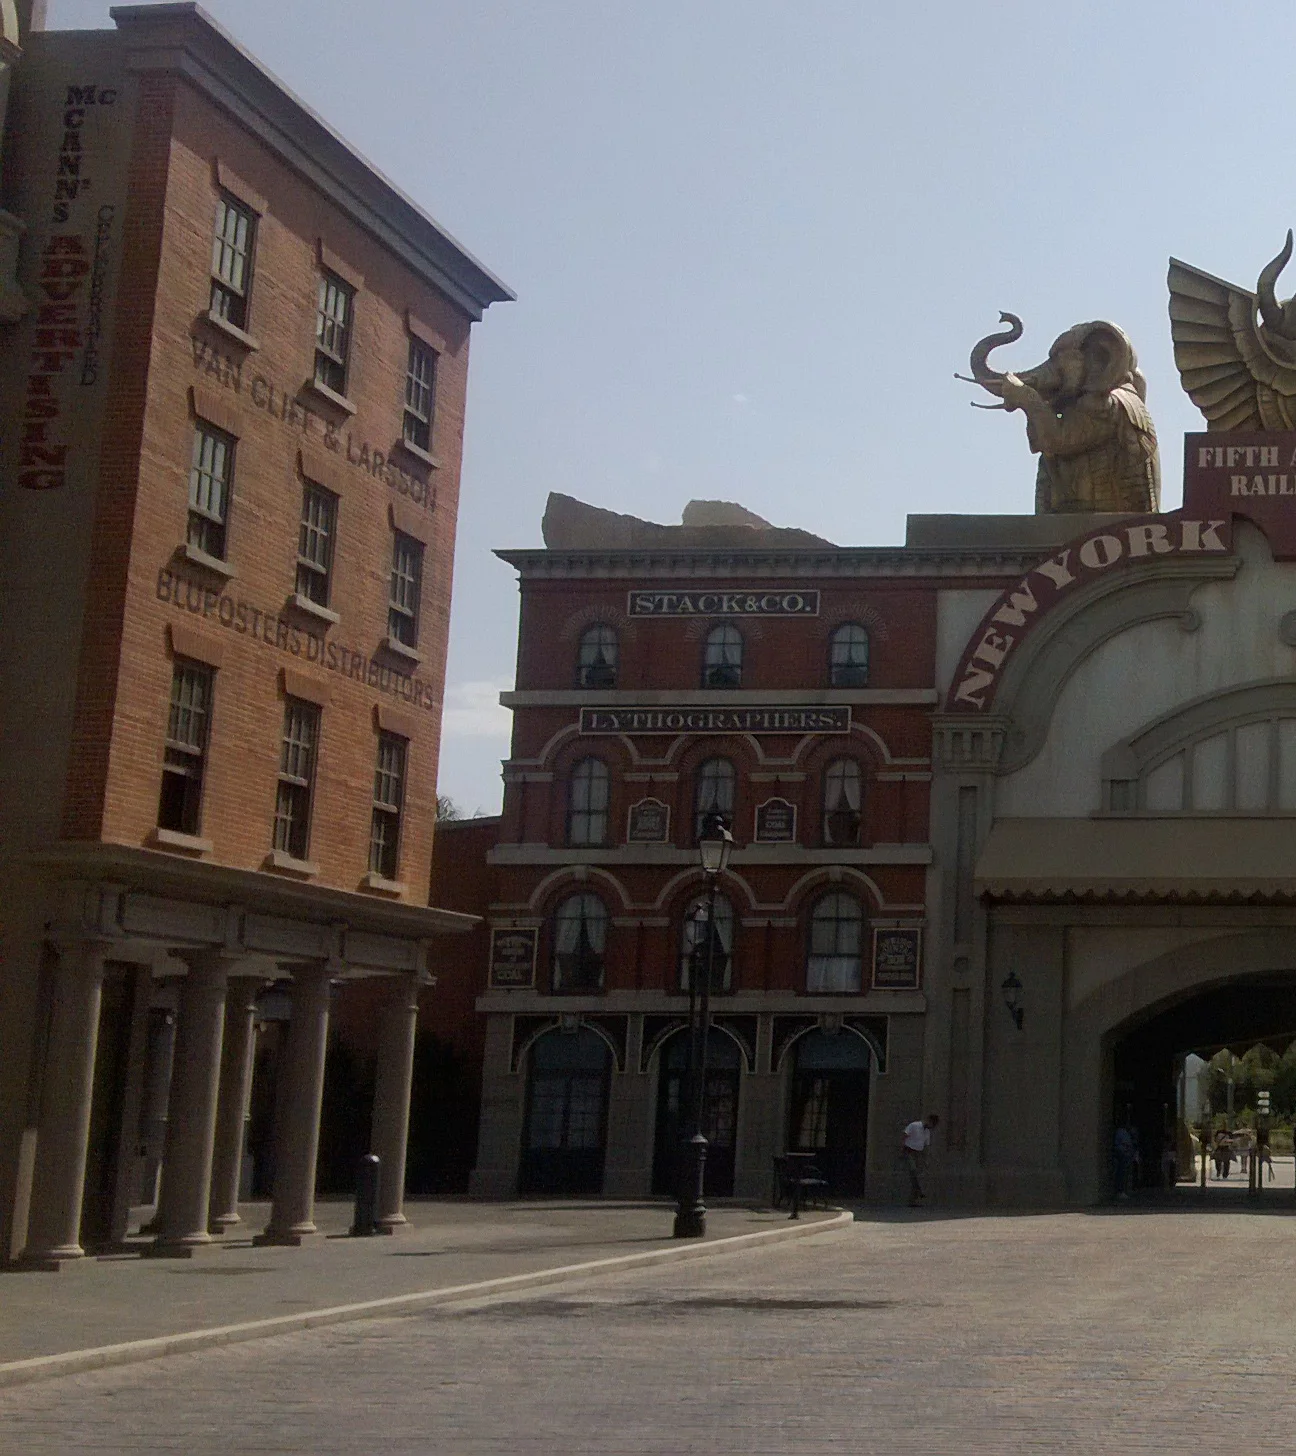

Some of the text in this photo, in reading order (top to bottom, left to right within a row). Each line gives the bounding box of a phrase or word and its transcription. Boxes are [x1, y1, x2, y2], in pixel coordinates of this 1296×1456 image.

[18, 235, 89, 490] ADVERTISING
[192, 338, 243, 394] VAN
[323, 421, 341, 452] &
[1198, 446, 1280, 467] FIFTH
[954, 577, 1038, 709] NEW
[1035, 519, 1226, 590] YORK
[306, 632, 434, 711] DISTRIBUTORS
